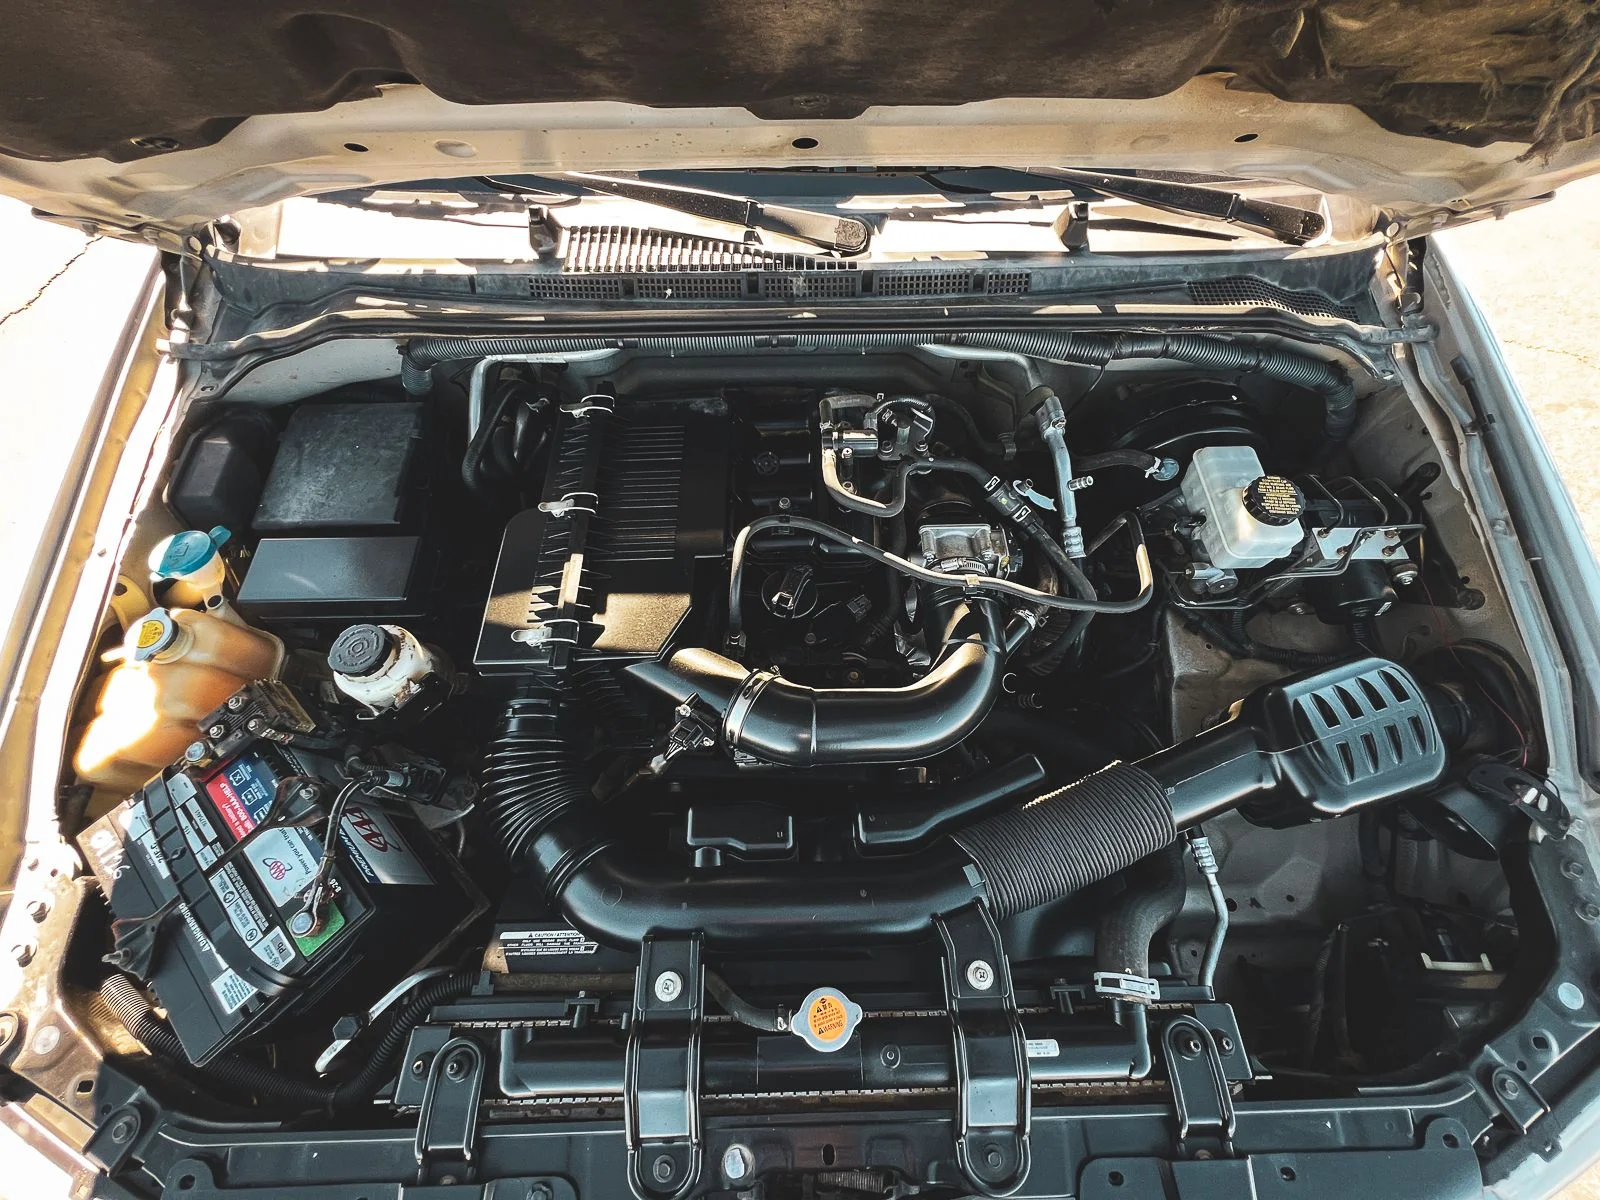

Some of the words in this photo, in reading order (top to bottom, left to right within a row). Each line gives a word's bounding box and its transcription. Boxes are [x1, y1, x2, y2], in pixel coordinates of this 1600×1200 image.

[218, 780, 248, 822] 800-AAA-HELP
[220, 800, 241, 824] battery?
[277, 826, 291, 842] trust
[286, 838, 296, 850] can
[292, 845, 305, 859] you
[341, 837, 375, 876] PREMIUM
[297, 857, 312, 875] Power
[276, 941, 287, 955] Pb
